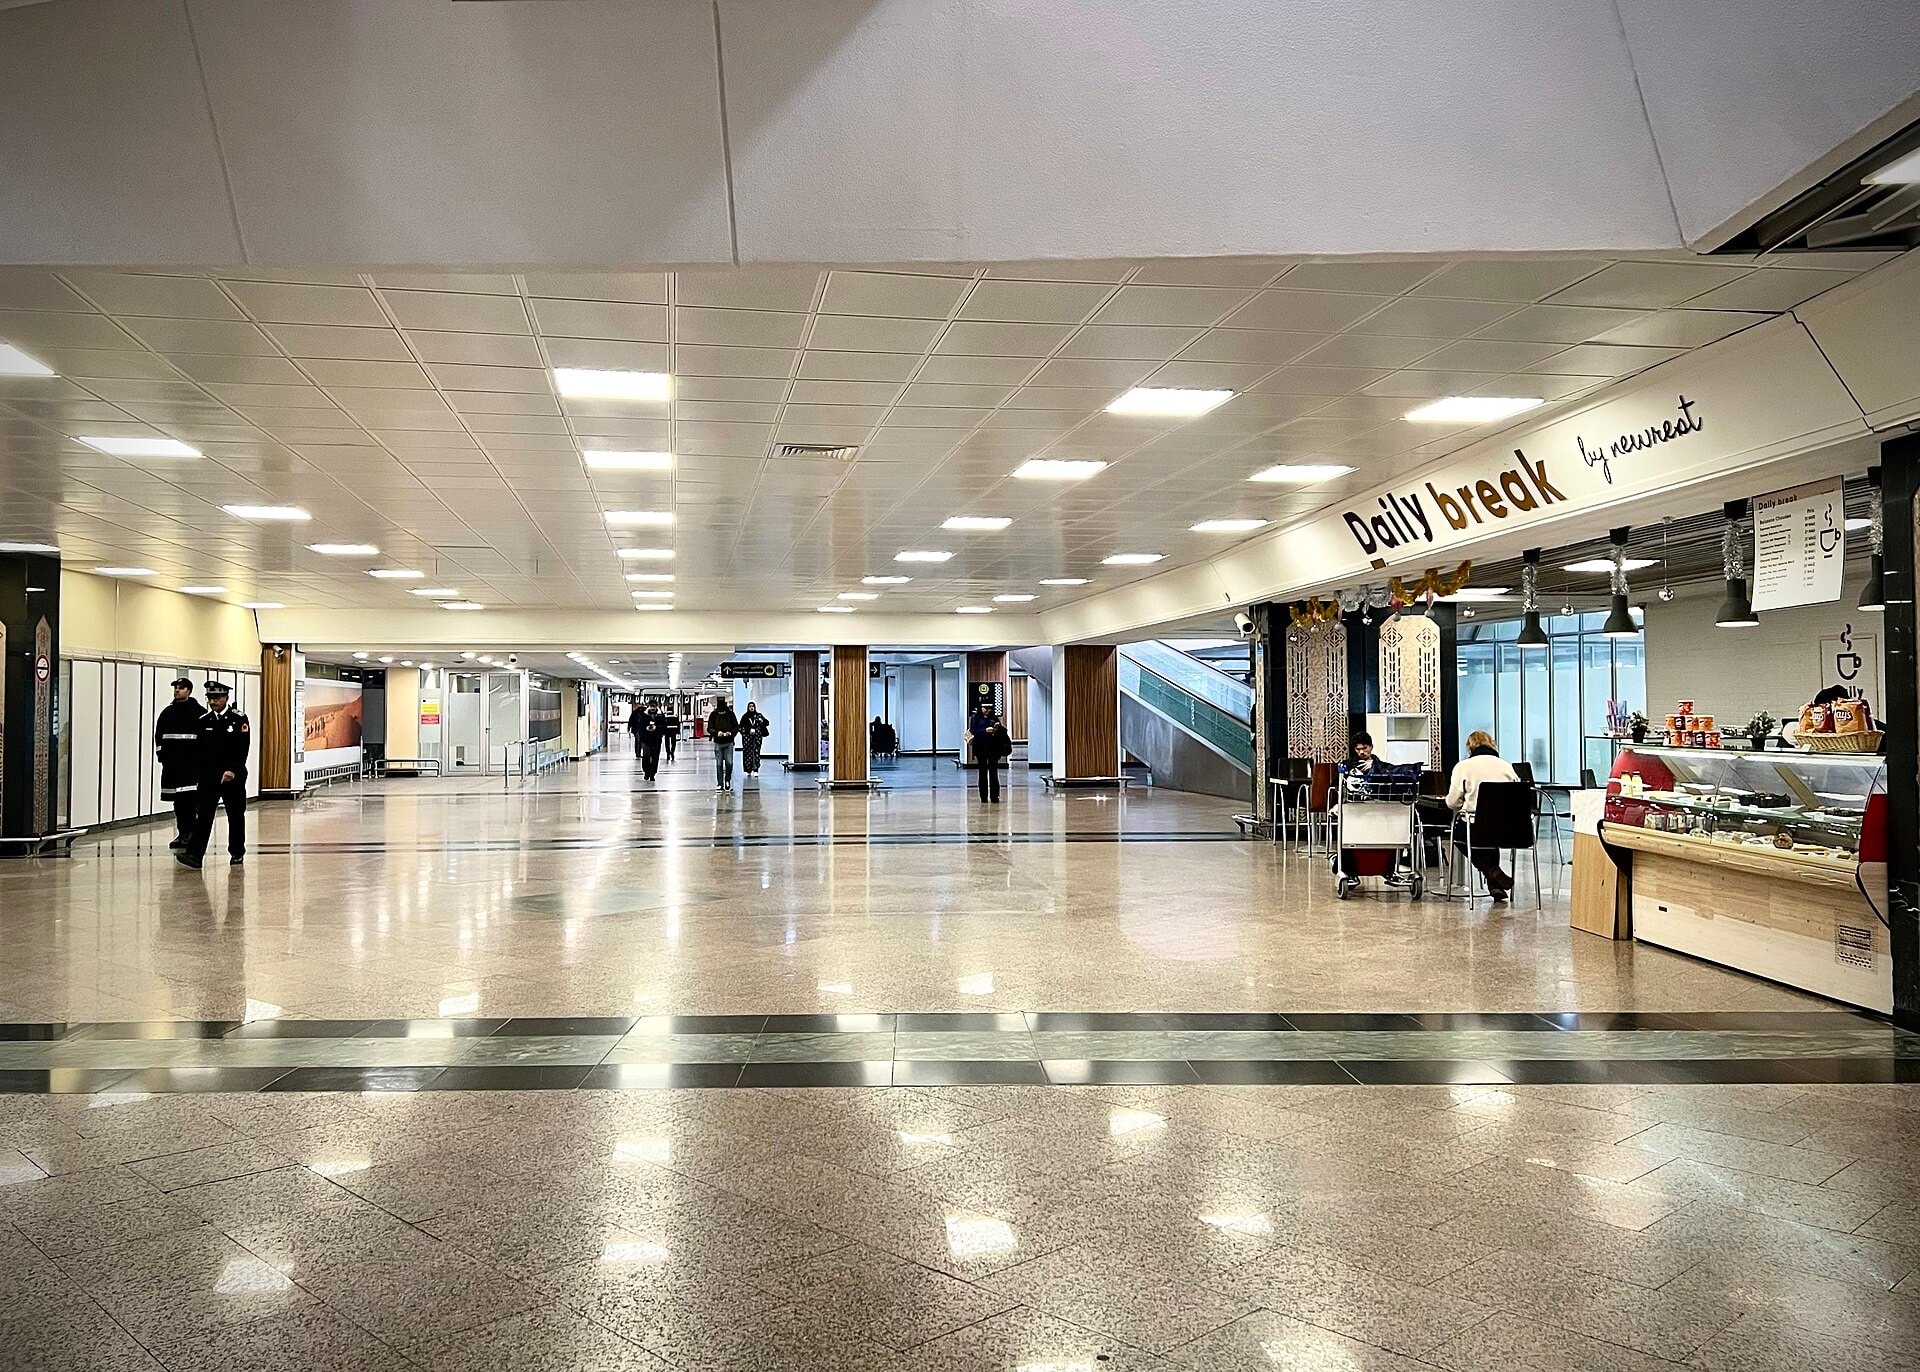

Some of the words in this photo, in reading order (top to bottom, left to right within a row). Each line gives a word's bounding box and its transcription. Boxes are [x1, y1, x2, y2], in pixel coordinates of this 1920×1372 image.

[1577, 436, 1612, 484] by
[1611, 394, 1702, 457] newrest
[1342, 493, 1433, 555] Daily
[1426, 449, 1568, 530] break
[1758, 499, 1776, 509] Daily
[1778, 494, 1798, 505] break
